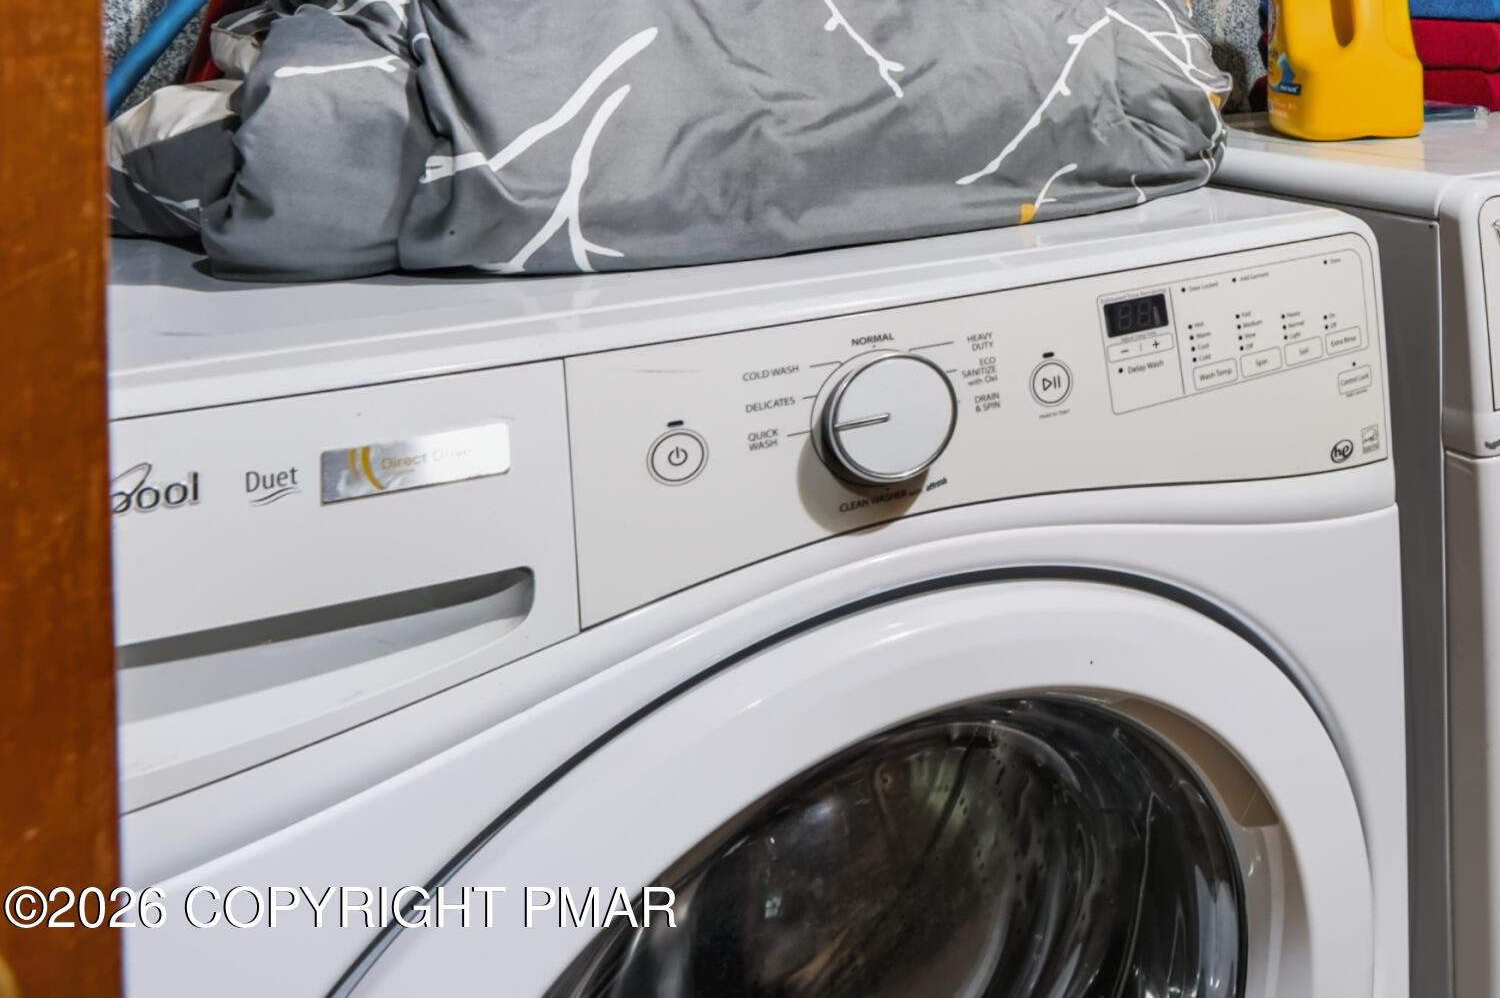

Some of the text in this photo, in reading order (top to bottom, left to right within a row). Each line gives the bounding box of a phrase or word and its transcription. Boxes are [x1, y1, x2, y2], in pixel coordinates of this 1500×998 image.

[851, 333, 895, 347] NORMAL
[966, 331, 993, 343] HEAVY
[972, 341, 994, 352] DUTY
[979, 356, 996, 366] ECO
[1128, 359, 1164, 375] Delay Wash
[742, 364, 800, 382] COLD WASH
[961, 365, 996, 379] SANITIZE
[745, 396, 796, 413] DELICATES
[974, 392, 1000, 404] DRAIN
[983, 401, 1001, 412] SPIN
[748, 429, 779, 443] QUICK
[749, 439, 779, 451] WASH
[381, 453, 427, 471] Direct
[245, 467, 299, 493] Duet
[839, 499, 869, 513] CLEAN
[870, 489, 907, 507] WASHER
